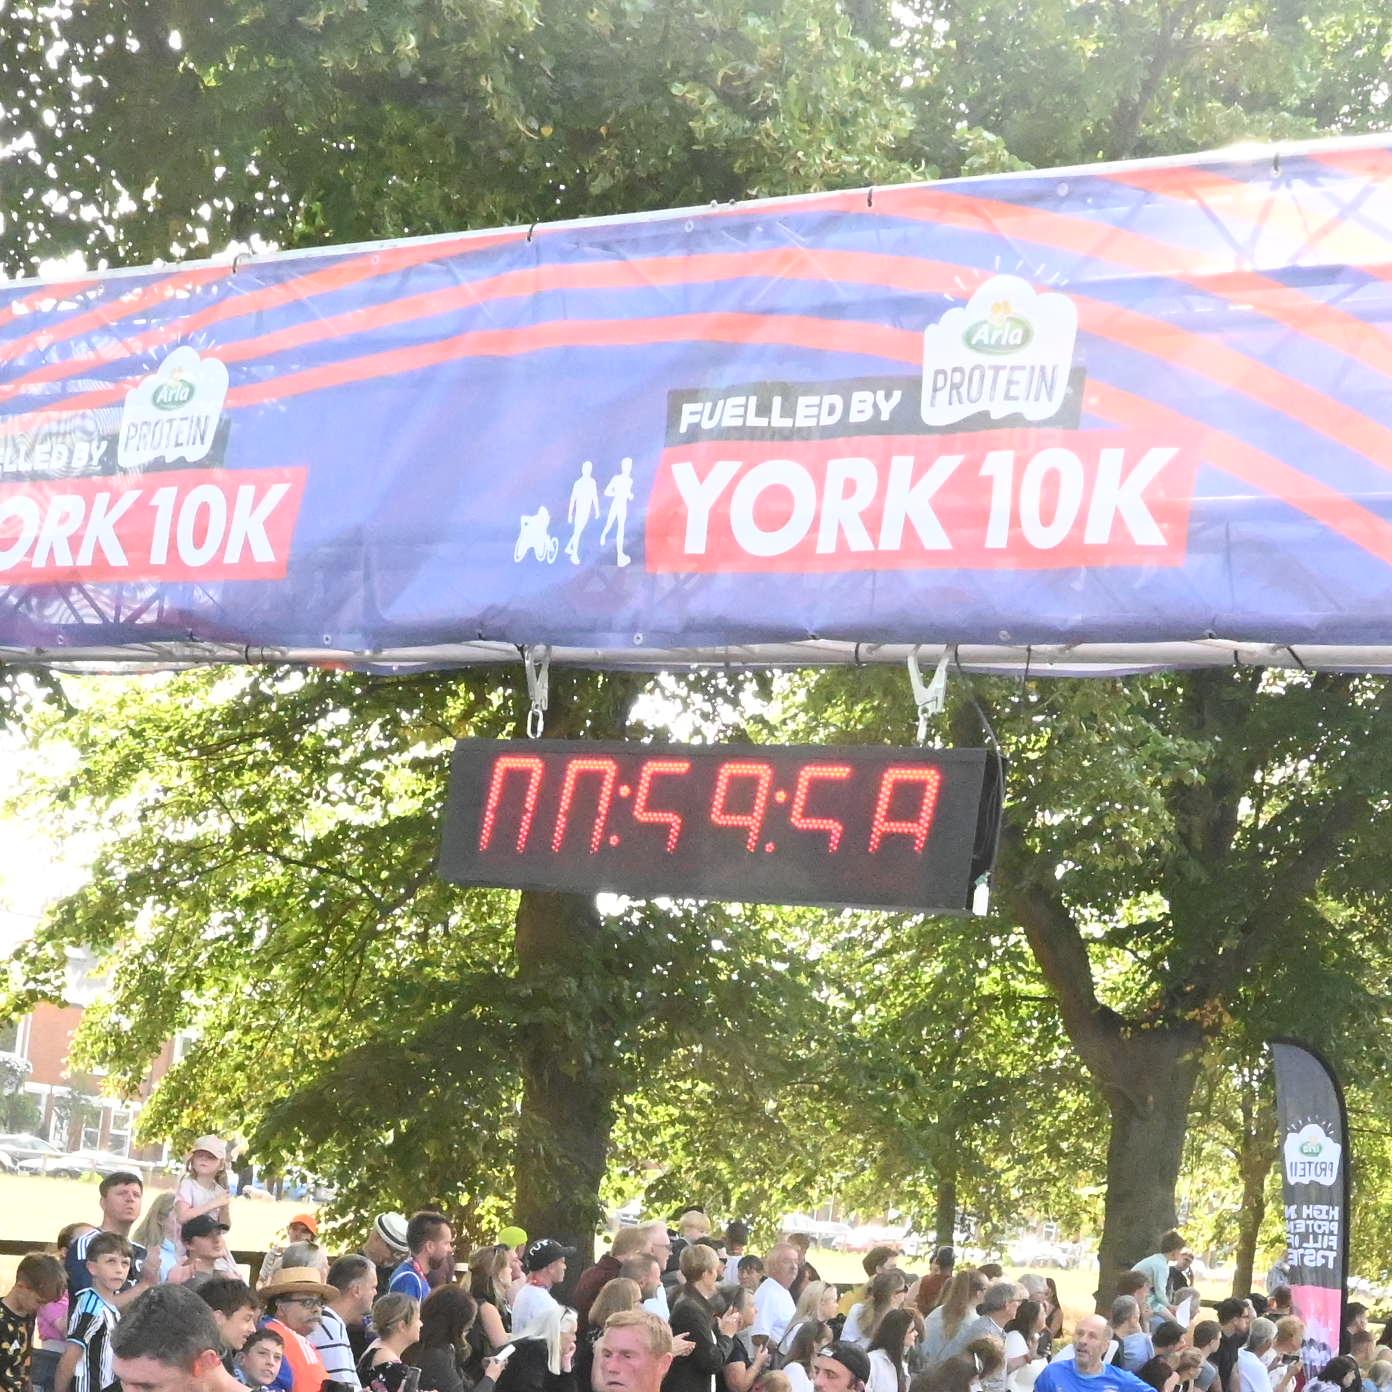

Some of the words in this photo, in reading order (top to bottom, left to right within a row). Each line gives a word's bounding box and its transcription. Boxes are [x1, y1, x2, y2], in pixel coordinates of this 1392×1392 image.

[971, 318, 1026, 347] Arla
[157, 382, 190, 405] Arla
[929, 363, 1059, 409] PROTEIN
[678, 393, 843, 434] FUELLED
[848, 389, 903, 423] BY
[72, 439, 109, 470] BY
[125, 414, 210, 454] PROTEIN
[670, 454, 966, 558] YORK
[978, 446, 1180, 550] 10K
[148, 482, 292, 568] 10K
